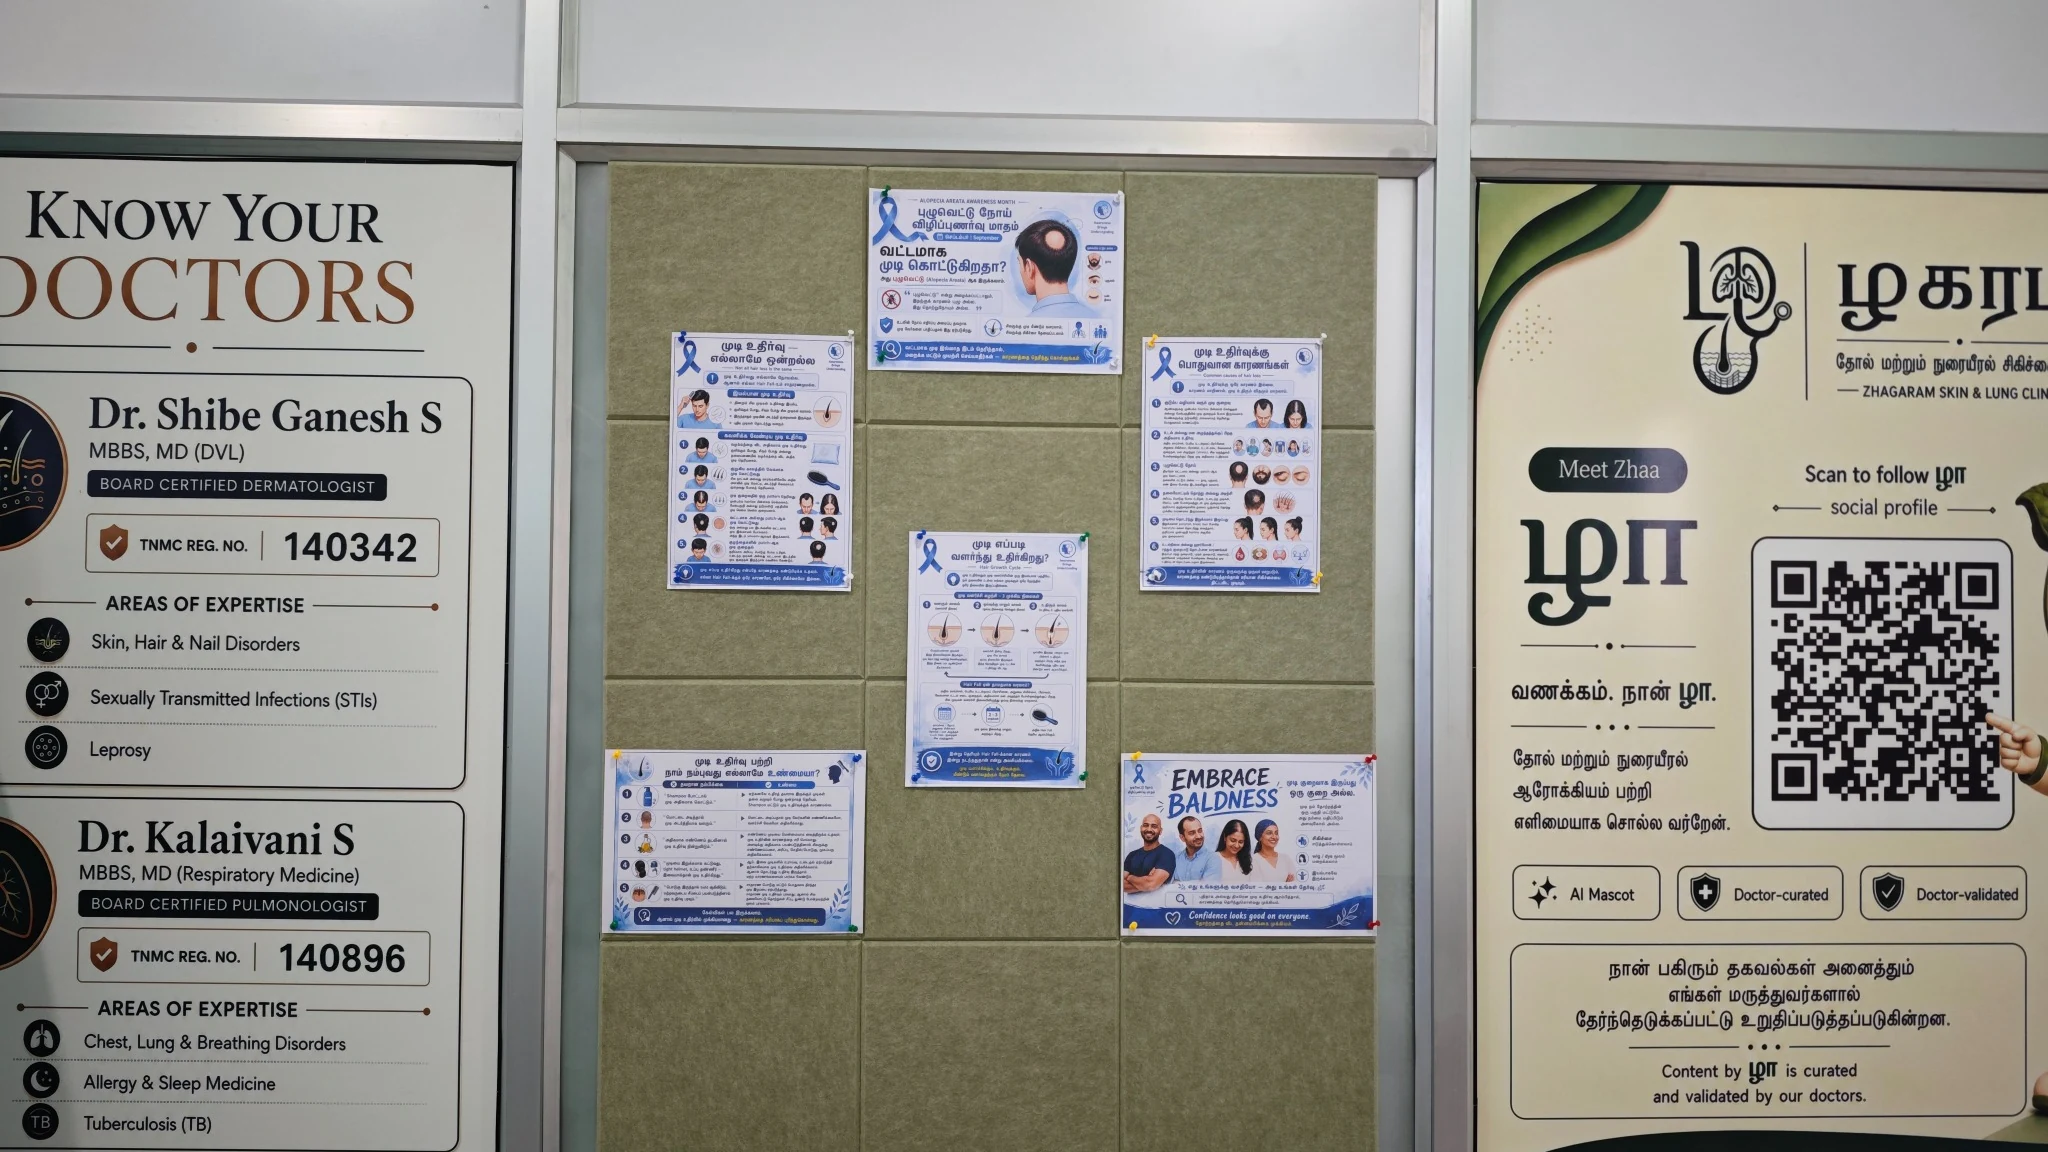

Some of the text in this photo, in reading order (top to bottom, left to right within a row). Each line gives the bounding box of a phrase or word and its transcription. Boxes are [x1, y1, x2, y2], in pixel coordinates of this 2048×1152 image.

[25, 191, 383, 243] KNOW YOUR
[880, 245, 947, 257] வட்டமாக
[880, 259, 1006, 275] முடி கொட்டுகிறதா?
[1836, 352, 1996, 376] தோல் மற்றும் நுரையீரல்
[1863, 386, 1935, 398] ZHAGARAM
[1940, 386, 1968, 398] SKIN
[1973, 387, 1981, 399] &
[1986, 387, 2018, 399] LUNG
[89, 397, 441, 433] Dr. Shibe Ganesh S
[90, 442, 244, 463] MBBS, MD (DVL)
[1559, 459, 1660, 478] Meet Zhaa
[1806, 465, 1966, 491] Scan to follow ழா
[101, 478, 375, 493] BOARD CERTIFIED DERMATOLOGIST
[1831, 498, 1937, 519] social profile
[140, 532, 416, 562] TNMC REG. NO. 140342
[1520, 519, 1697, 626] ழா
[106, 596, 304, 613] AREAS OF EXPERTISE
[92, 634, 300, 651] Skin, Hair & Nail Disorders
[91, 689, 377, 710] Sexually Transmitted Infections (STIs)
[1512, 679, 1613, 700] வணக்கம்.
[1622, 680, 1671, 706] நான்
[91, 741, 151, 761] Leprosy
[1514, 749, 1688, 772] தோல் மற்றும் நுரையீரல்
[1171, 768, 1270, 791] EMBRACE
[1513, 781, 1651, 802] ஆரோக்கியம் பற்றி
[1167, 788, 1278, 819] BALDNESS
[1515, 812, 1730, 834] எளிமையாக சொல்ல வர்றேன்.
[78, 820, 354, 855] Dr. Kalaivani S
[80, 865, 359, 886] MBBS, MD (Respiratory Medicine)
[92, 898, 367, 912] BOARD CERTIFIED PULMONOLOGIST
[1570, 888, 1634, 901] AI Mascot
[1735, 888, 1828, 901] Doctor-curated
[1917, 888, 2018, 901] Doctor-validated
[1188, 910, 1227, 920] Confidence
[1229, 911, 1246, 919] looks
[1249, 912, 1266, 922] good
[1278, 913, 1311, 921] everyone.
[131, 944, 405, 972] TNMC REG. NO. 140896
[1609, 958, 1914, 981] நான் பகிரும் தகவல்கள் அனைத்தும்
[1669, 985, 1860, 1007] எங்கள் மருத்துவர்களால்
[98, 1000, 297, 1017] AREAS OF EXPERTISE
[1576, 1009, 1950, 1032] தேர்ந்தெடுக்கப்பட்டு உறுதிப்படுத்தப்படுகின்றன.
[84, 1034, 346, 1054] Chest, Lung & Breathing Disorders
[1662, 1062, 1857, 1084] Content by ழா is curated
[84, 1075, 275, 1094] Allergy & Sleep Medicine
[1654, 1088, 1866, 1106] and validated by our doctors.
[31, 1116, 50, 1128] TB
[84, 1116, 211, 1134] Tuberculosis (TB)
